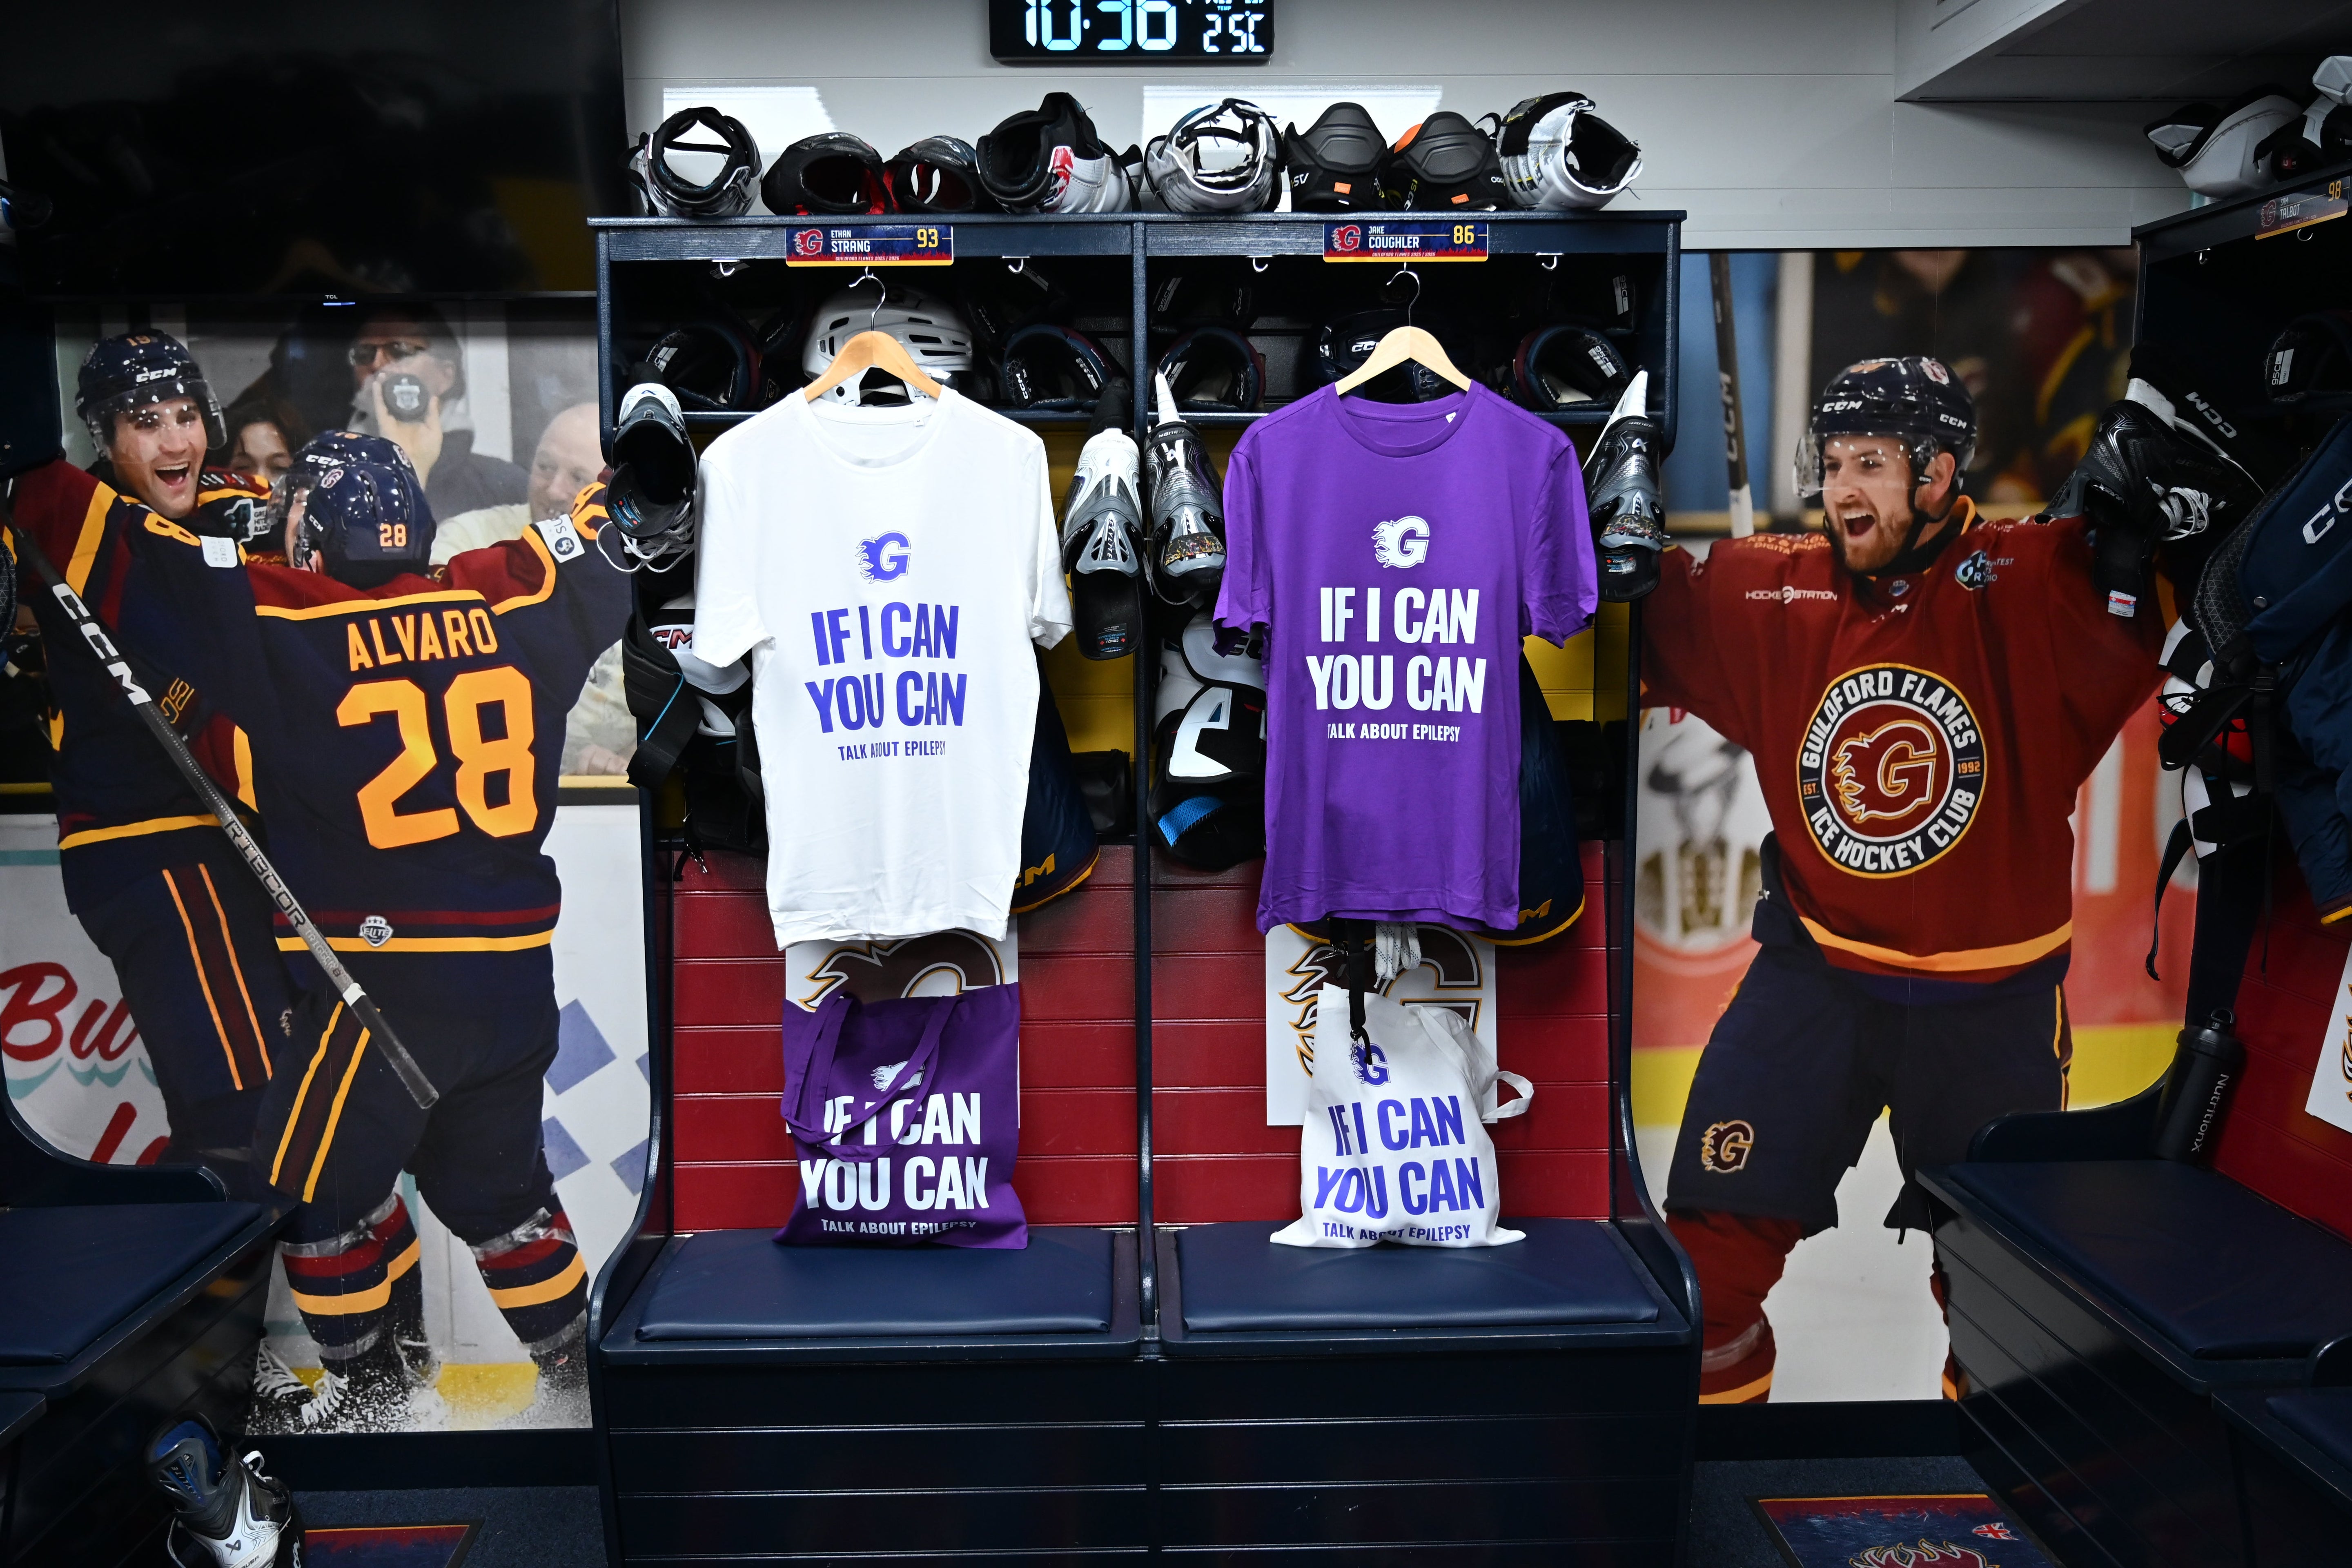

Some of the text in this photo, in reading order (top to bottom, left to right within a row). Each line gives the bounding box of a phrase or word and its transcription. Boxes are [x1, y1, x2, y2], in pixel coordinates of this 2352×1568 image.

[2328, 180, 2342, 202] 98
[2280, 197, 2288, 206] SAM
[2280, 204, 2301, 220] TALBOT
[831, 230, 851, 238] ETHAN
[917, 228, 938, 248] 93
[1368, 226, 1385, 234] JAKE
[1453, 225, 1474, 244] 86
[831, 240, 871, 253] STRANG
[1369, 236, 1419, 249] COUGHLER
[1619, 274, 1628, 297] 95C
[1351, 341, 1380, 352] CC
[1594, 345, 1609, 363] 95C
[136, 368, 177, 383] CCM
[2272, 364, 2282, 385] 95C
[1016, 373, 1029, 400] CCM
[1822, 401, 1863, 413] CCM
[2185, 391, 2237, 439] CCM
[1940, 413, 1967, 429] CCM
[309, 514, 324, 532] CCM
[379, 524, 407, 547] 28
[1107, 518, 1116, 559] FLYLITE
[1320, 587, 1479, 644] IF I CAN
[52, 583, 152, 705] CCM
[347, 607, 498, 672] ALVARO
[811, 602, 959, 666] IF I CAN
[1306, 654, 1487, 713] YOU CAN
[804, 671, 967, 733] YOU CAN
[1802, 670, 1977, 769] GUILDFORD FLAMES
[1327, 724, 1460, 742] TALK ABOUT EPILEPSY
[336, 664, 538, 849] 28
[838, 741, 946, 761] TALK ABOUT EPILEPSY
[1957, 760, 1981, 775] 1992
[1803, 782, 1820, 795] EST.
[1810, 789, 1976, 871] ICE HOCKEY CLUB
[224, 820, 307, 928] RIBCOR
[363, 927, 392, 938] ELITE
[823, 1095, 855, 1146] IF
[890, 1092, 981, 1145] CAN
[1327, 1095, 1466, 1156] IF I CAN
[800, 1156, 990, 1211] YOU CAN
[1314, 1157, 1485, 1219] YOU CAN
[821, 1218, 976, 1235] TALK ABOUT EPILEPSY
[1322, 1222, 1355, 1239] TALK
[1408, 1224, 1471, 1242] EPILEPSY
